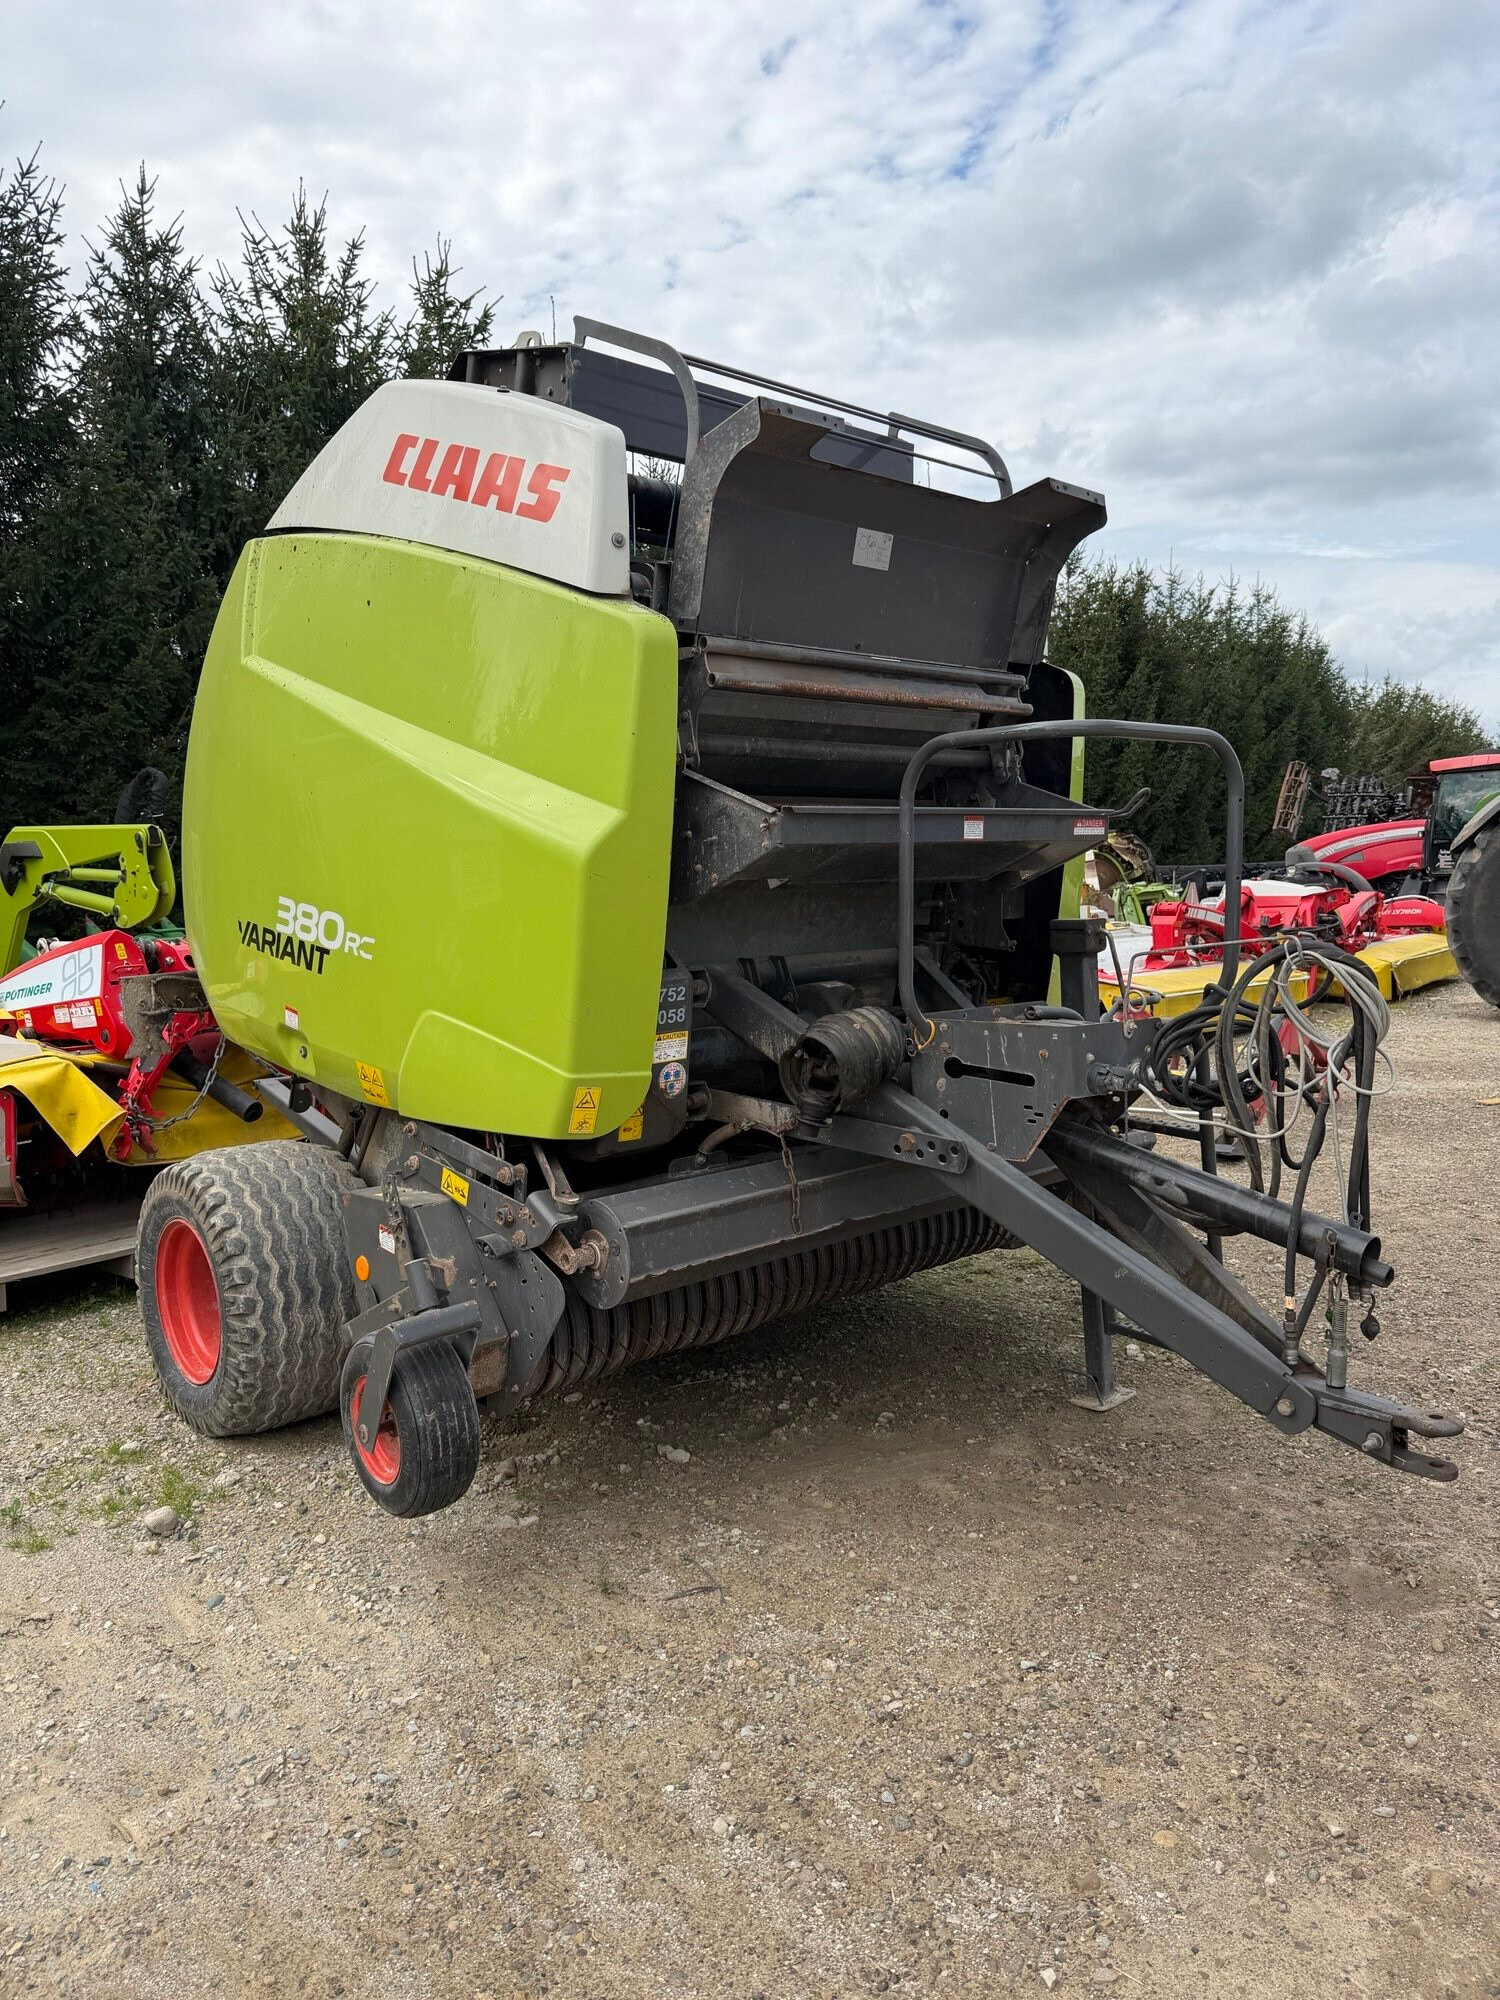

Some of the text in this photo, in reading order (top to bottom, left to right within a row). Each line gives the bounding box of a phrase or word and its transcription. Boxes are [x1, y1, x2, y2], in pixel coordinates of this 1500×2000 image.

[383, 433, 571, 523] CLAAS
[276, 896, 376, 961] 380 RC
[238, 920, 331, 975] VARIANT
[660, 986, 686, 1003] 752
[658, 1007, 686, 1025] 058
[662, 1032, 686, 1041] CAUTION
